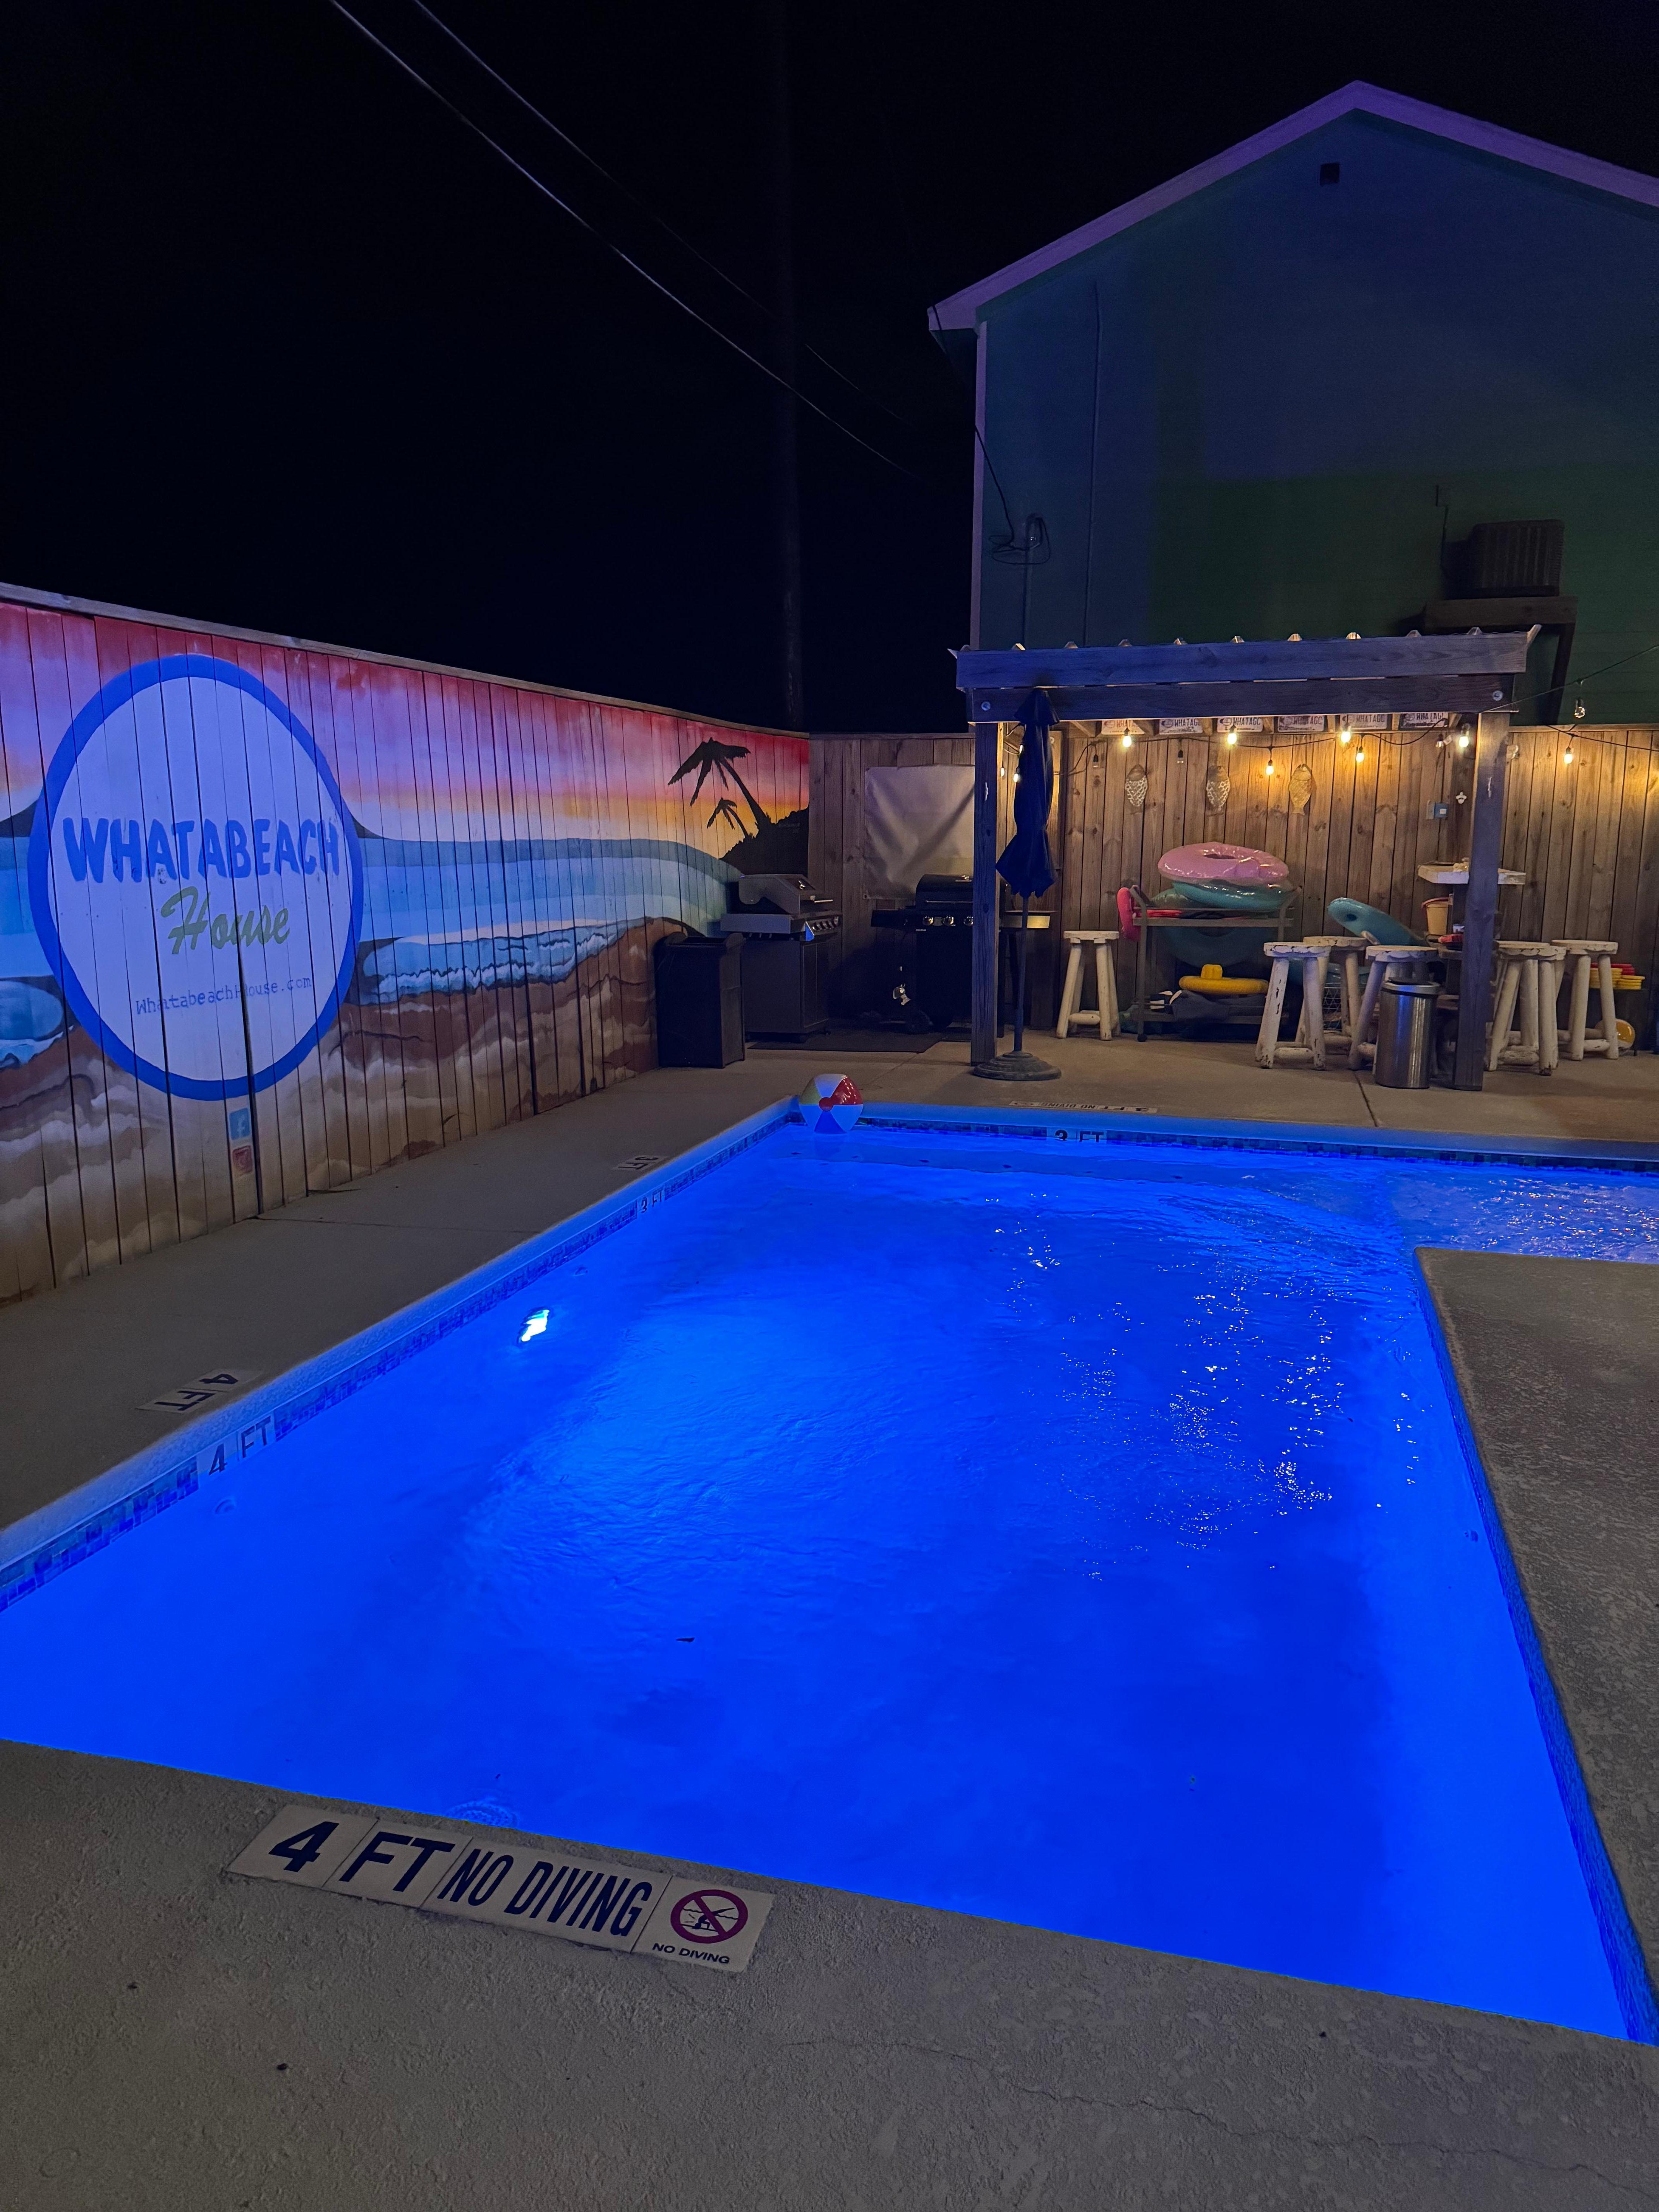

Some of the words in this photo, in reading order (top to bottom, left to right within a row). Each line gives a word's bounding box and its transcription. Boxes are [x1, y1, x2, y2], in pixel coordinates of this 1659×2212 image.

[63, 817, 340, 883] WHATABEACH
[161, 886, 290, 955] House
[154, 1390, 216, 1411] FT
[199, 1373, 239, 1385] 4
[209, 1443, 227, 1476] 4
[241, 1415, 271, 1459] FT
[268, 1821, 340, 1873] 4
[338, 1831, 455, 1893] FT
[436, 1848, 514, 1906] NO
[503, 1860, 652, 1937] DIVING
[652, 1943, 675, 1953] NO
[678, 1948, 730, 1964] DIVING
